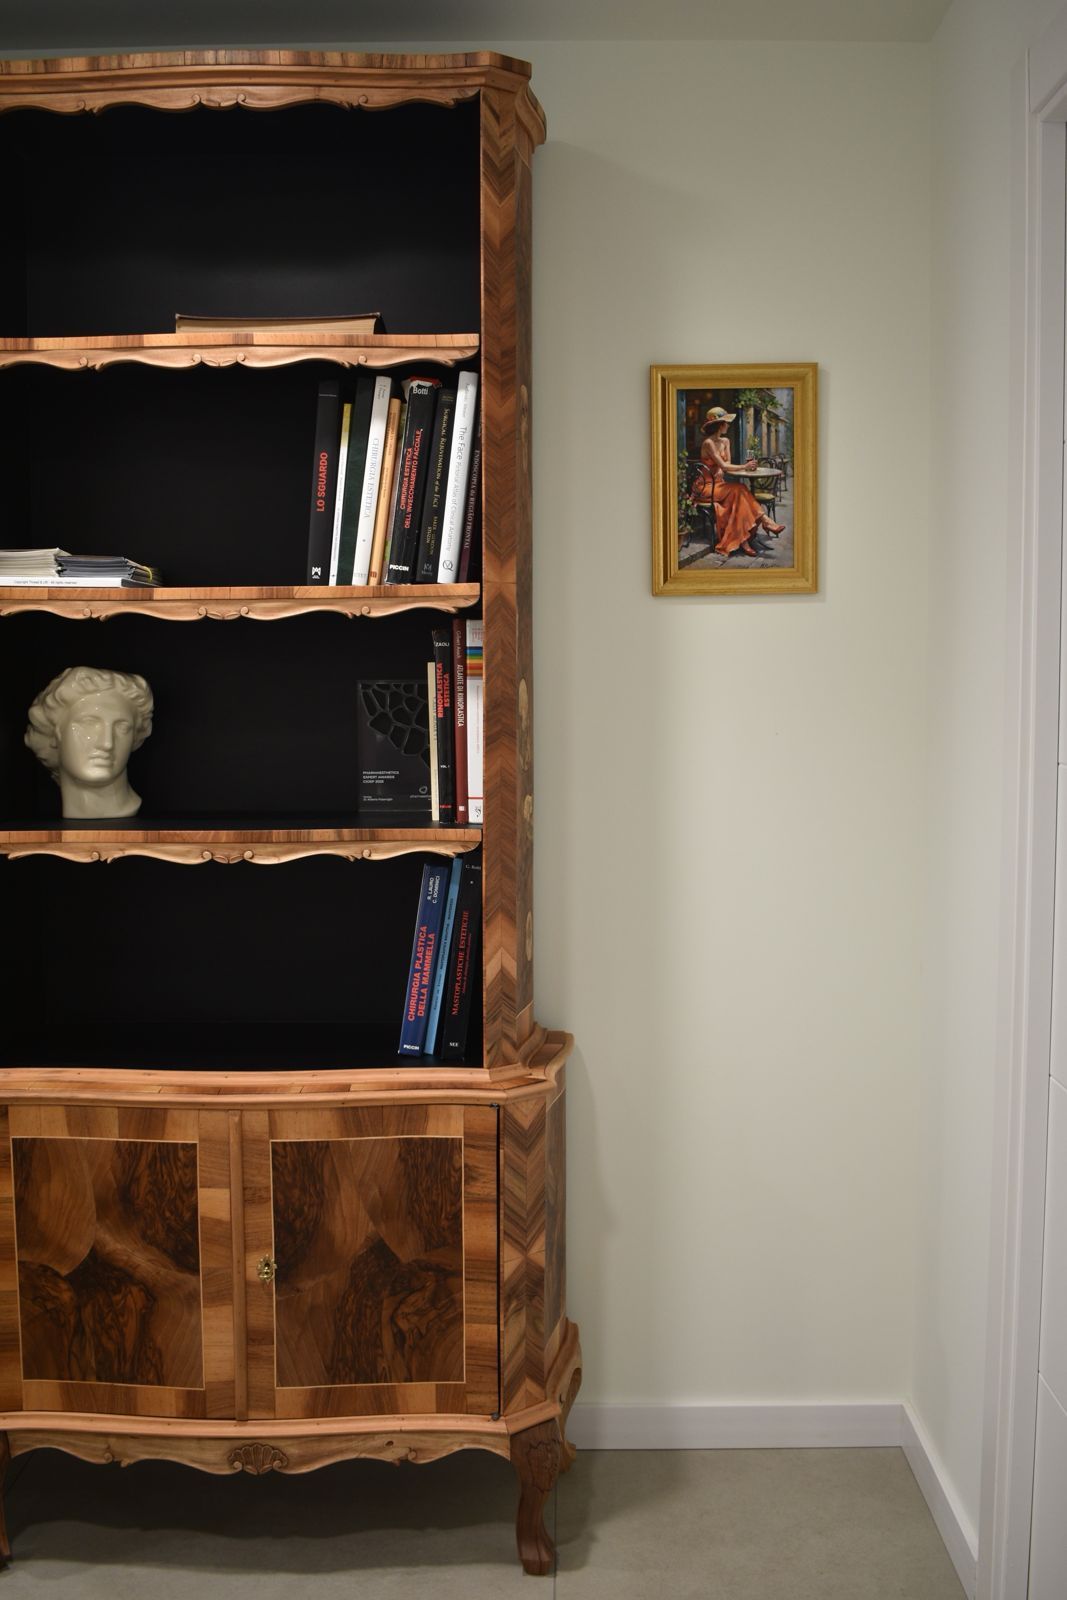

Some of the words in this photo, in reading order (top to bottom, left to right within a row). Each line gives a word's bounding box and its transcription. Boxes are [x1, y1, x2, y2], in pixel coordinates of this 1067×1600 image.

[413, 386, 429, 395] Botti
[413, 430, 422, 460] FACCIALE
[458, 426, 467, 441] The
[369, 438, 379, 480] CHIRURGIA
[404, 447, 413, 476] ESTETICA
[456, 442, 465, 460] Face
[317, 452, 329, 498] SGUARDO
[316, 500, 325, 512] LO
[364, 483, 374, 519] ESTETICA
[400, 477, 409, 510] CHIRURGIA
[389, 564, 410, 572] PICCIN
[457, 693, 465, 727] RINOPLASTICA
[408, 972, 421, 1021] CHIRURGIA
[415, 925, 428, 969] PLASTICA
[421, 933, 435, 985] MAMMELLA
[452, 952, 465, 1016] MASTOPLASTICHE
[459, 911, 469, 949] ESTETICHE
[417, 987, 428, 1017] DELLA
